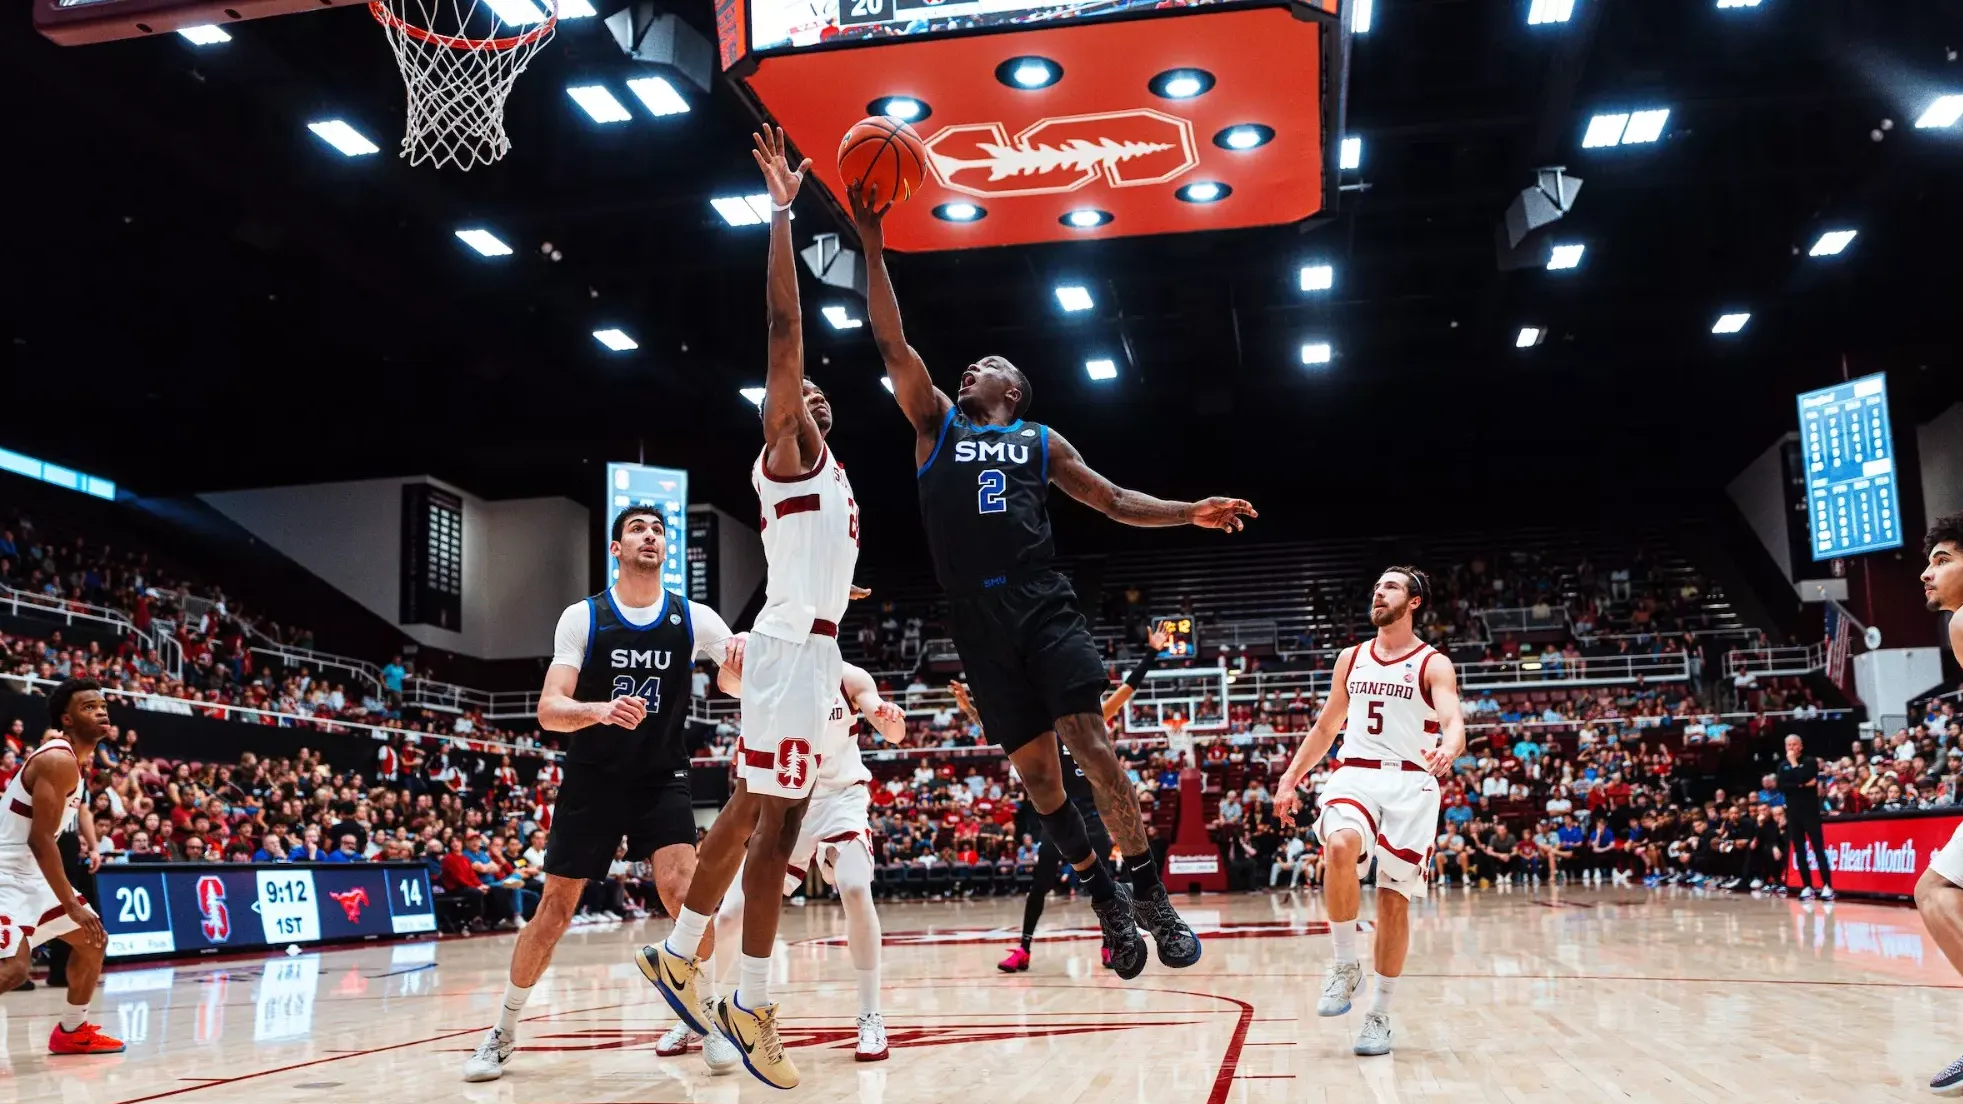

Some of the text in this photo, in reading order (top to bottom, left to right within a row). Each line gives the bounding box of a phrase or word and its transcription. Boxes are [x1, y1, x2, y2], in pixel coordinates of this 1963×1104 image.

[955, 441, 1028, 464] SMU
[978, 469, 1006, 514] 2
[984, 574, 1007, 588] SMU
[611, 648, 672, 670] SMU
[611, 674, 660, 713] 24
[1349, 681, 1414, 700] STANFORD
[1367, 701, 1384, 735] 5
[1839, 841, 1872, 872] Heart
[1872, 838, 1916, 874] Month
[116, 886, 152, 922] 20
[266, 881, 308, 903] 9:12
[400, 878, 423, 907] 14
[276, 918, 303, 934] 1ST
